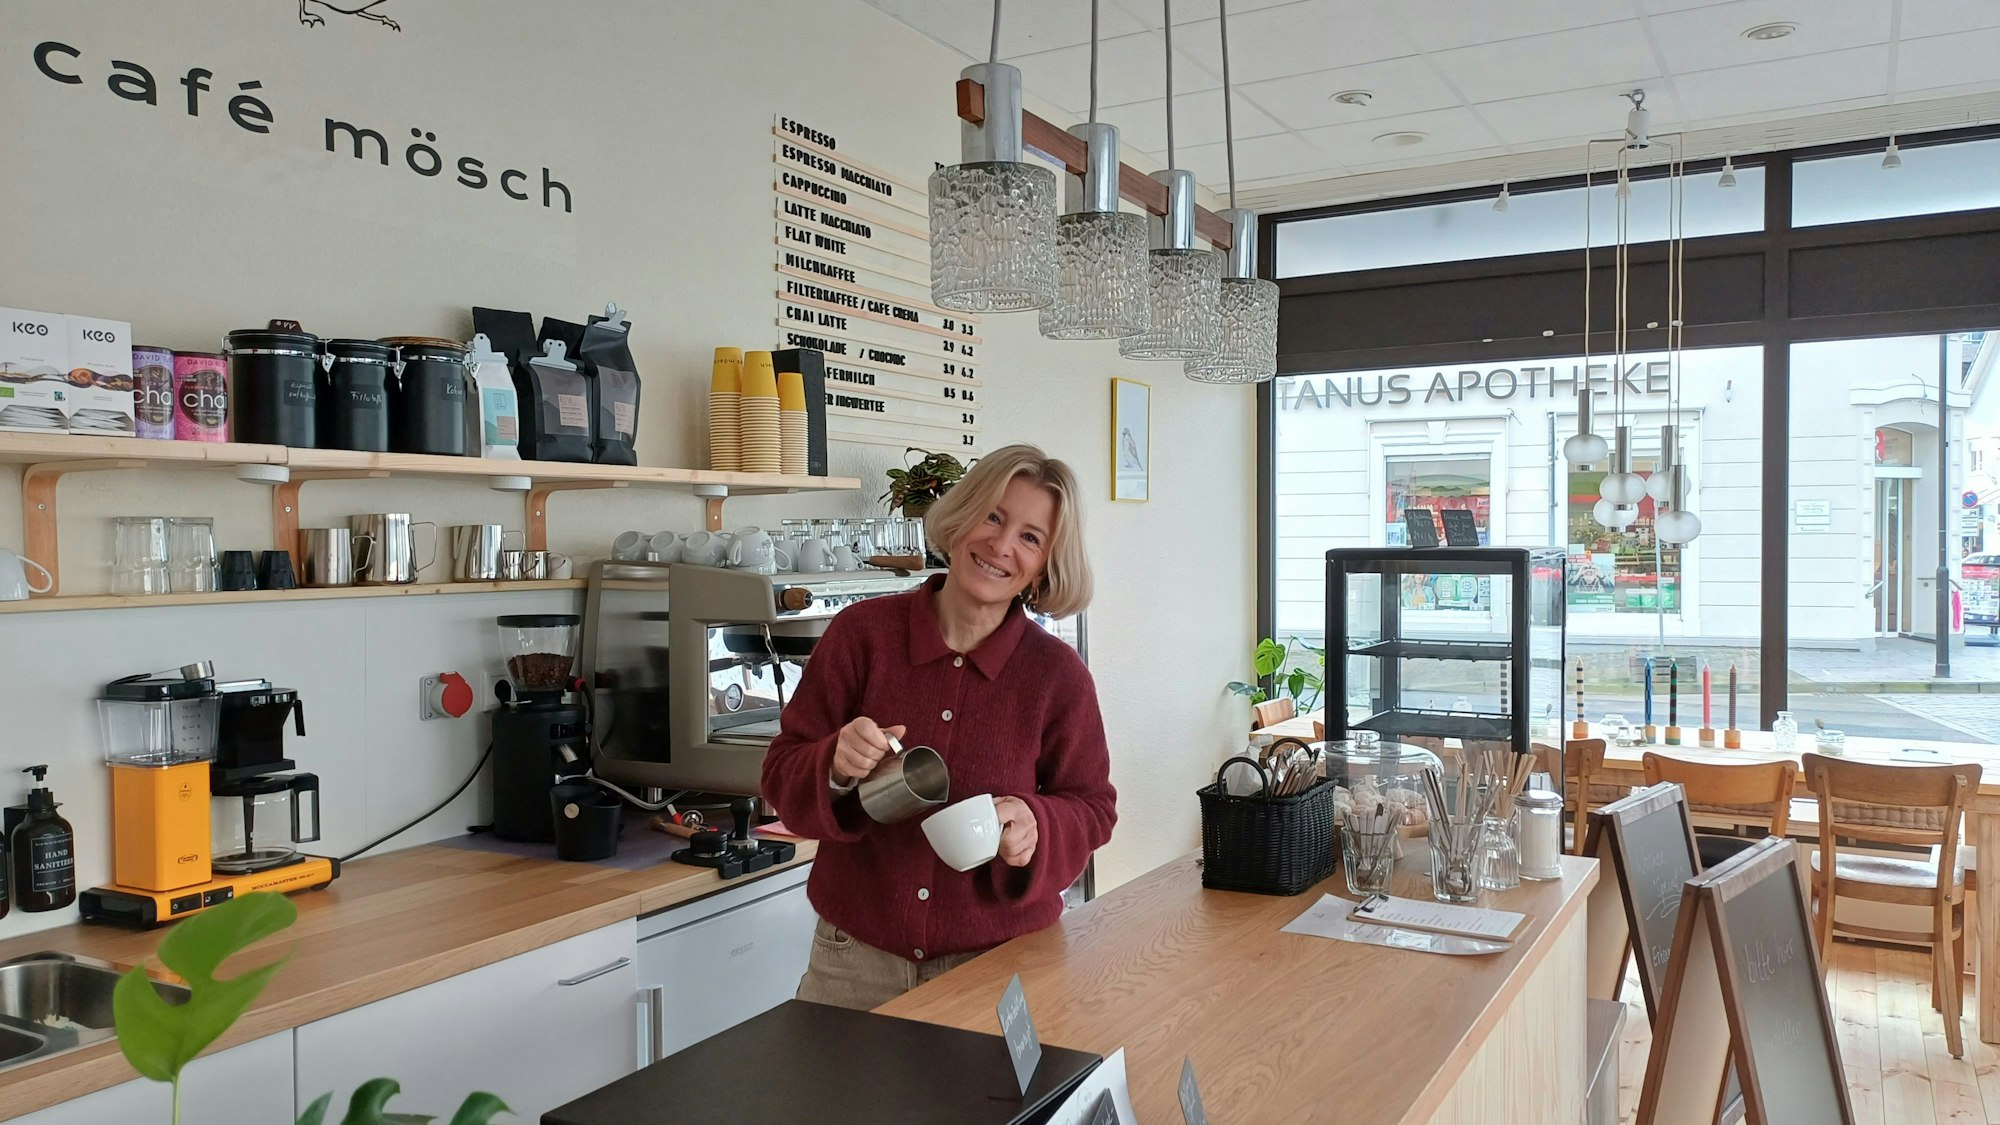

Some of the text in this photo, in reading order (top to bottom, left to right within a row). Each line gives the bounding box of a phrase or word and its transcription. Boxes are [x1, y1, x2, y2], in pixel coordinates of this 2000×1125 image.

[33, 40, 573, 214] café mösch
[781, 117, 836, 150] ESPRESSO
[782, 144, 892, 196] ESPRESSO MACCHIATO
[782, 172, 847, 205] CAPPUCCINO
[784, 200, 872, 239] LATTE MACCHIATO
[785, 226, 847, 255] FLAT WHITE
[785, 253, 855, 283] MILCHKAFFEE
[787, 280, 859, 308] FILTERKAFFEE
[868, 300, 890, 316] CAFE
[893, 307, 919, 323] CREMA
[786, 306, 814, 323] CHAI
[819, 312, 847, 331] LATTE
[787, 333, 847, 355] SCHOKOLADE
[187, 358, 213, 367] DAVID
[825, 366, 875, 386] FERMILCH
[1278, 361, 1672, 411] TANUS APOTHEKE
[835, 394, 885, 413] INGWERTEE
[45, 849, 68, 859] HAND
